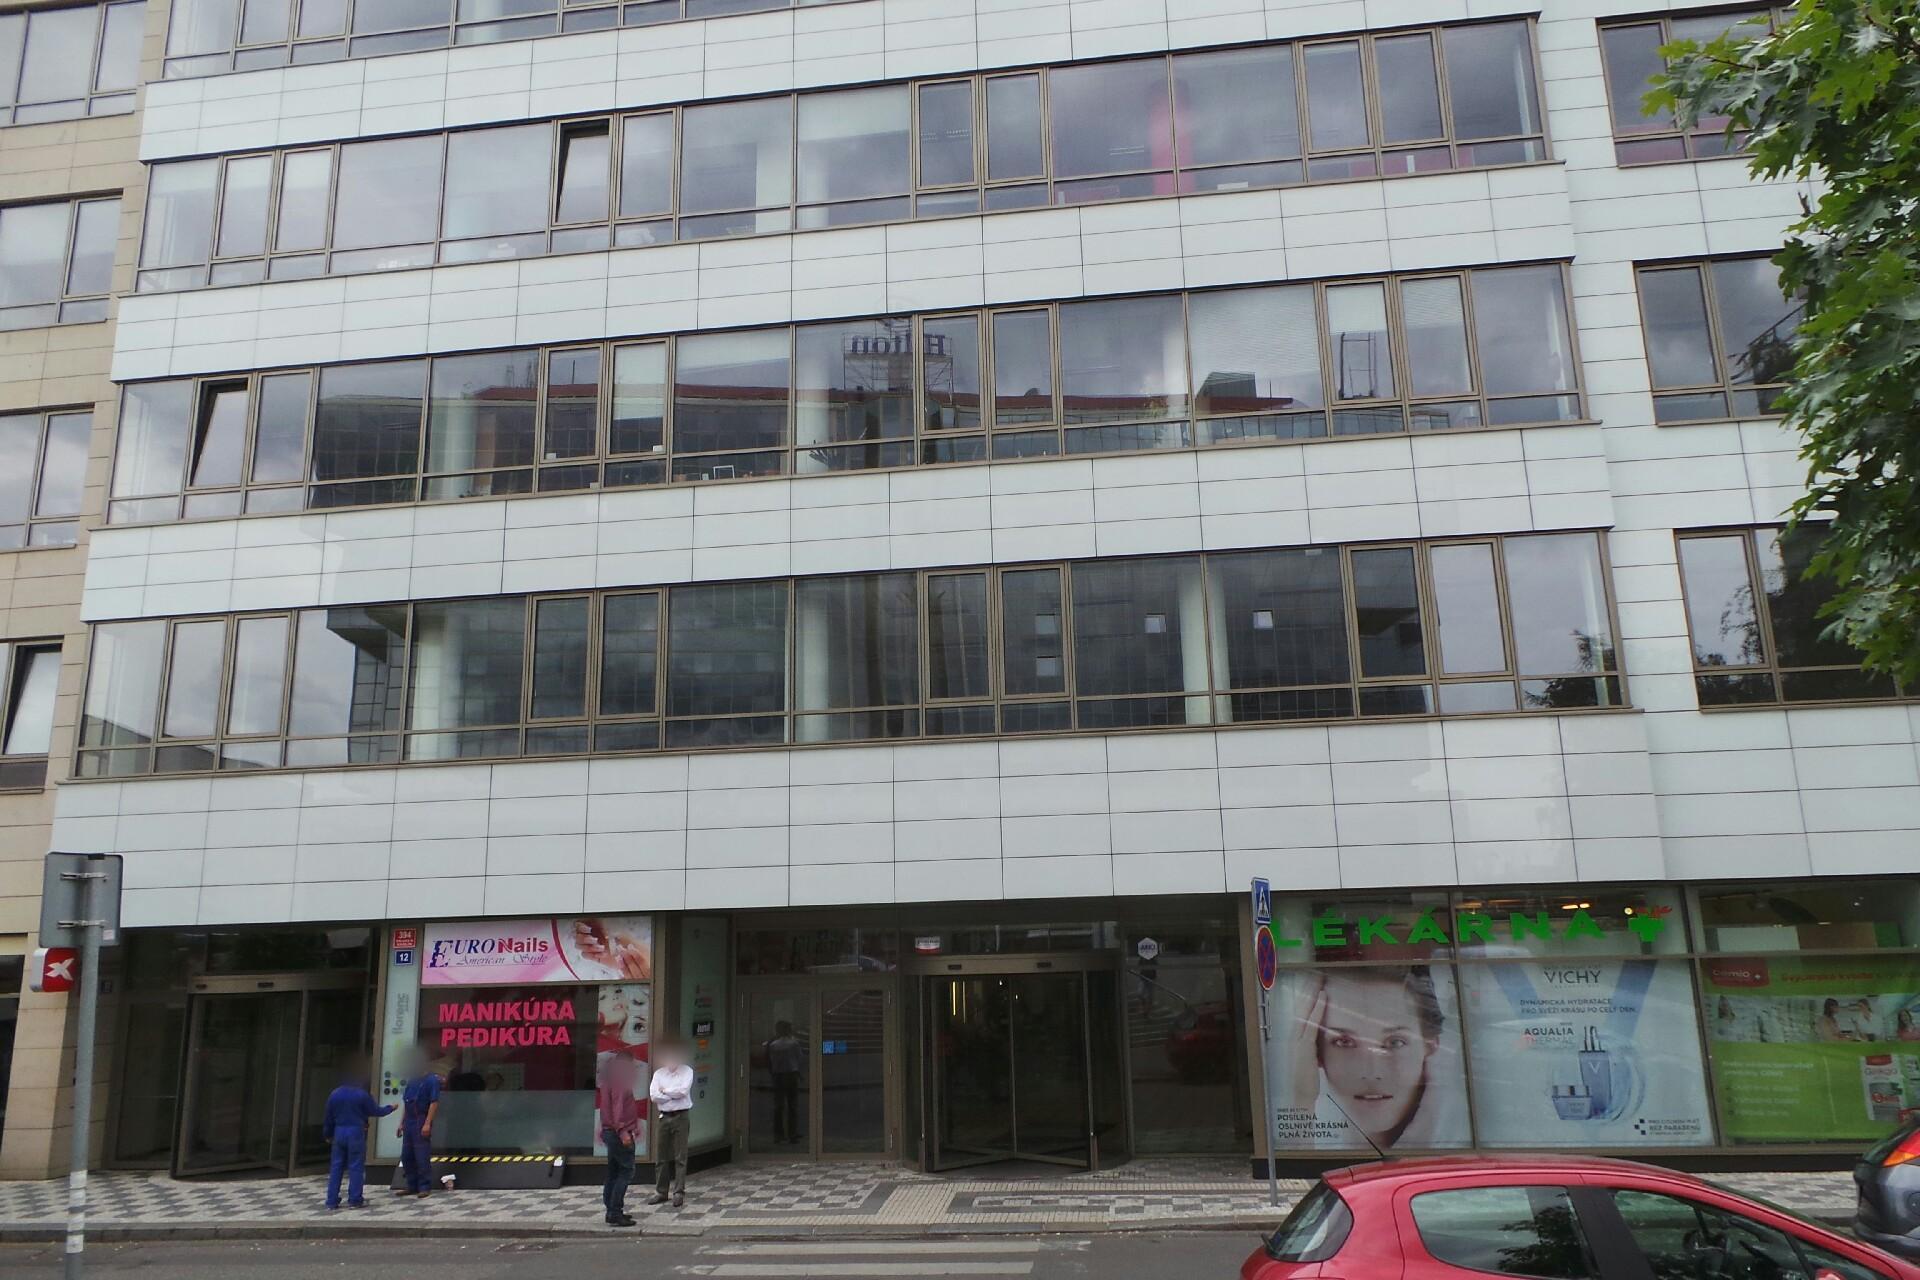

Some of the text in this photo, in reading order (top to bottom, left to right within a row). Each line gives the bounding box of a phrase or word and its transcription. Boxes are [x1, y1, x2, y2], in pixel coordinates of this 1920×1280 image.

[1271, 907, 1606, 947] LÉKÁRNA
[400, 953, 409, 962] 12
[428, 937, 548, 968] EURO Nails
[1544, 970, 1601, 984] VICHY
[439, 996, 576, 1022] MANIKÚRA
[441, 1022, 570, 1047] PEDIKÚRA
[1524, 1027, 1574, 1036] AQUALIA
[1315, 1119, 1349, 1129] KRÁSNÁ
[1279, 1130, 1300, 1139] PLNÁ
